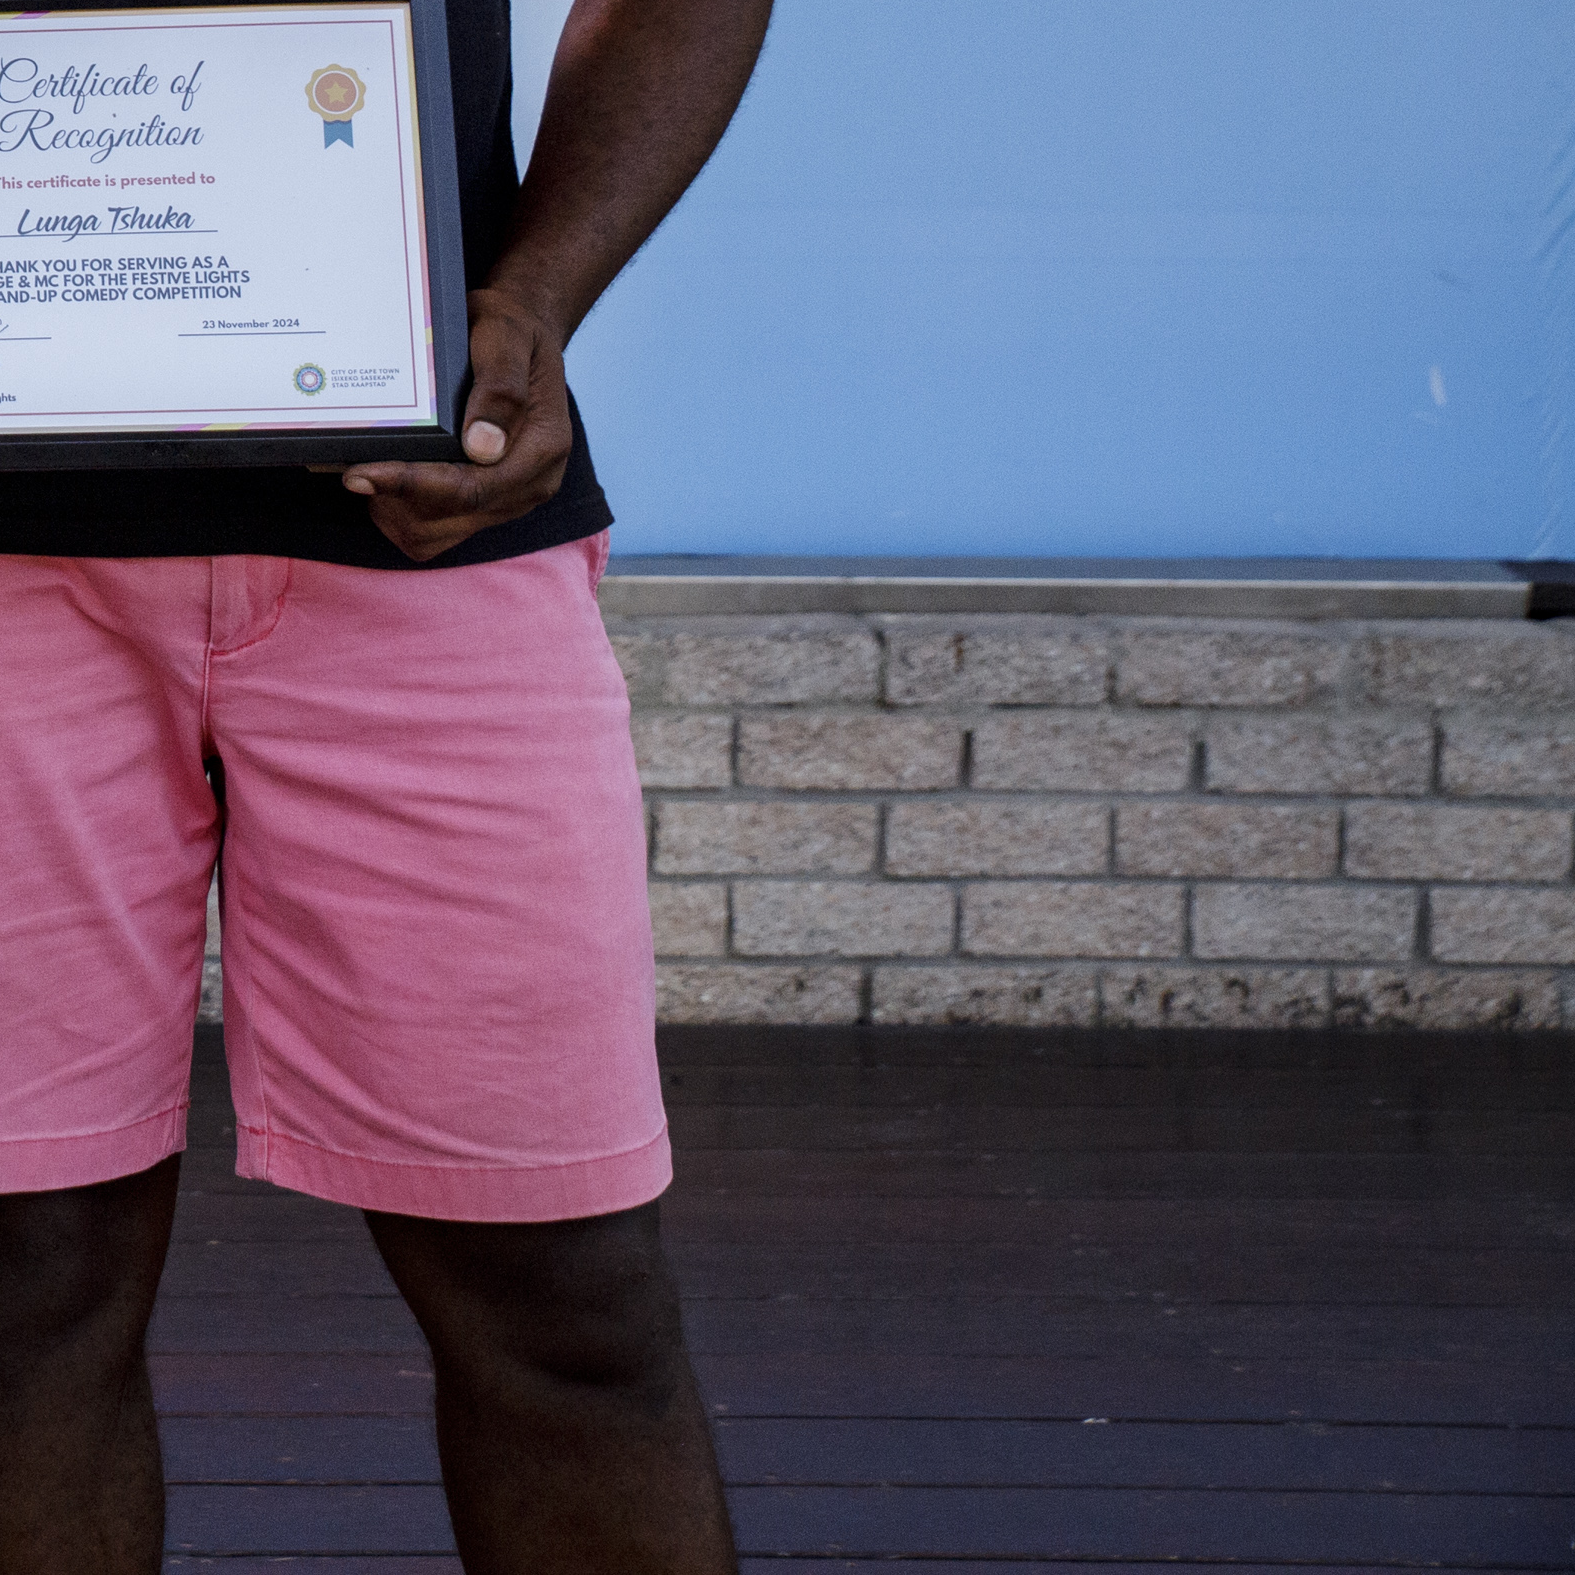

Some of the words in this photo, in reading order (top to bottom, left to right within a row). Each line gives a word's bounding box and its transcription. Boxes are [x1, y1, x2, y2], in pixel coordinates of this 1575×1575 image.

[170, 60, 205, 112] of
[27, 174, 101, 188] certificate
[105, 174, 116, 186] is
[121, 171, 196, 190] presented
[200, 173, 215, 184] to
[17, 209, 101, 243] Lunga
[107, 205, 195, 233] Tshuka
[41, 259, 77, 272] YOU
[81, 258, 113, 272] FOR
[117, 256, 187, 271] SERVING
[191, 256, 213, 269] AS
[217, 256, 229, 268] A
[18, 275, 31, 288] &
[34, 274, 59, 288] MC
[63, 274, 95, 287] FOR
[98, 273, 127, 286] THE
[132, 271, 191, 285] FESTIVE
[195, 270, 250, 284] LIGHTS
[61, 288, 129, 302] COMEDY
[133, 285, 241, 300] COMPETITION
[202, 320, 216, 329] 23
[218, 319, 270, 329] November
[272, 318, 300, 328] 2024
